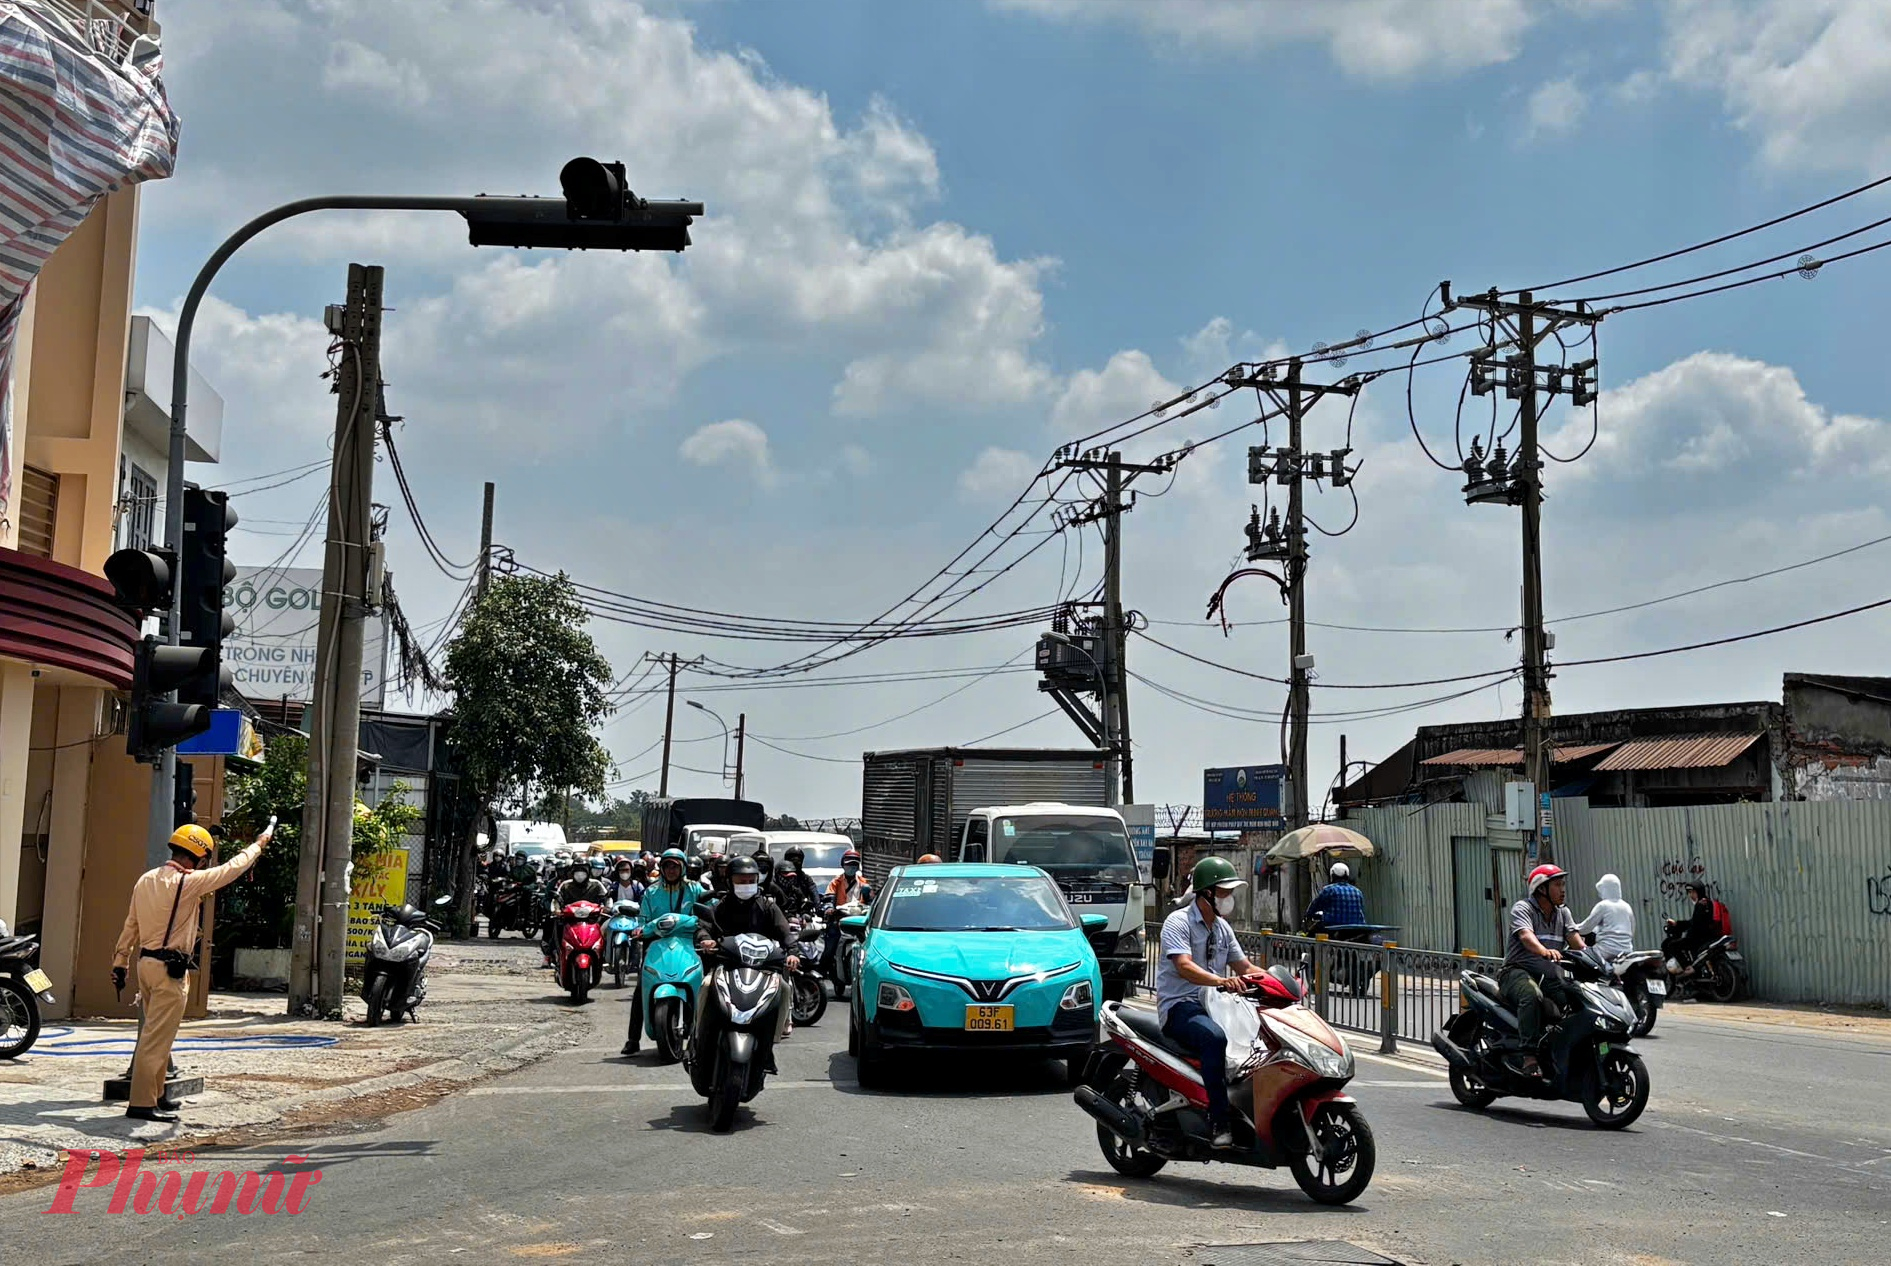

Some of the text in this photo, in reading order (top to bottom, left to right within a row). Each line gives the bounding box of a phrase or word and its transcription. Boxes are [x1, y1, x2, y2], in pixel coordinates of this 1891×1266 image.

[235, 666, 304, 683] CHUYÊN
[979, 1006, 1000, 1018] 63F
[970, 1018, 1007, 1030] 009.61
